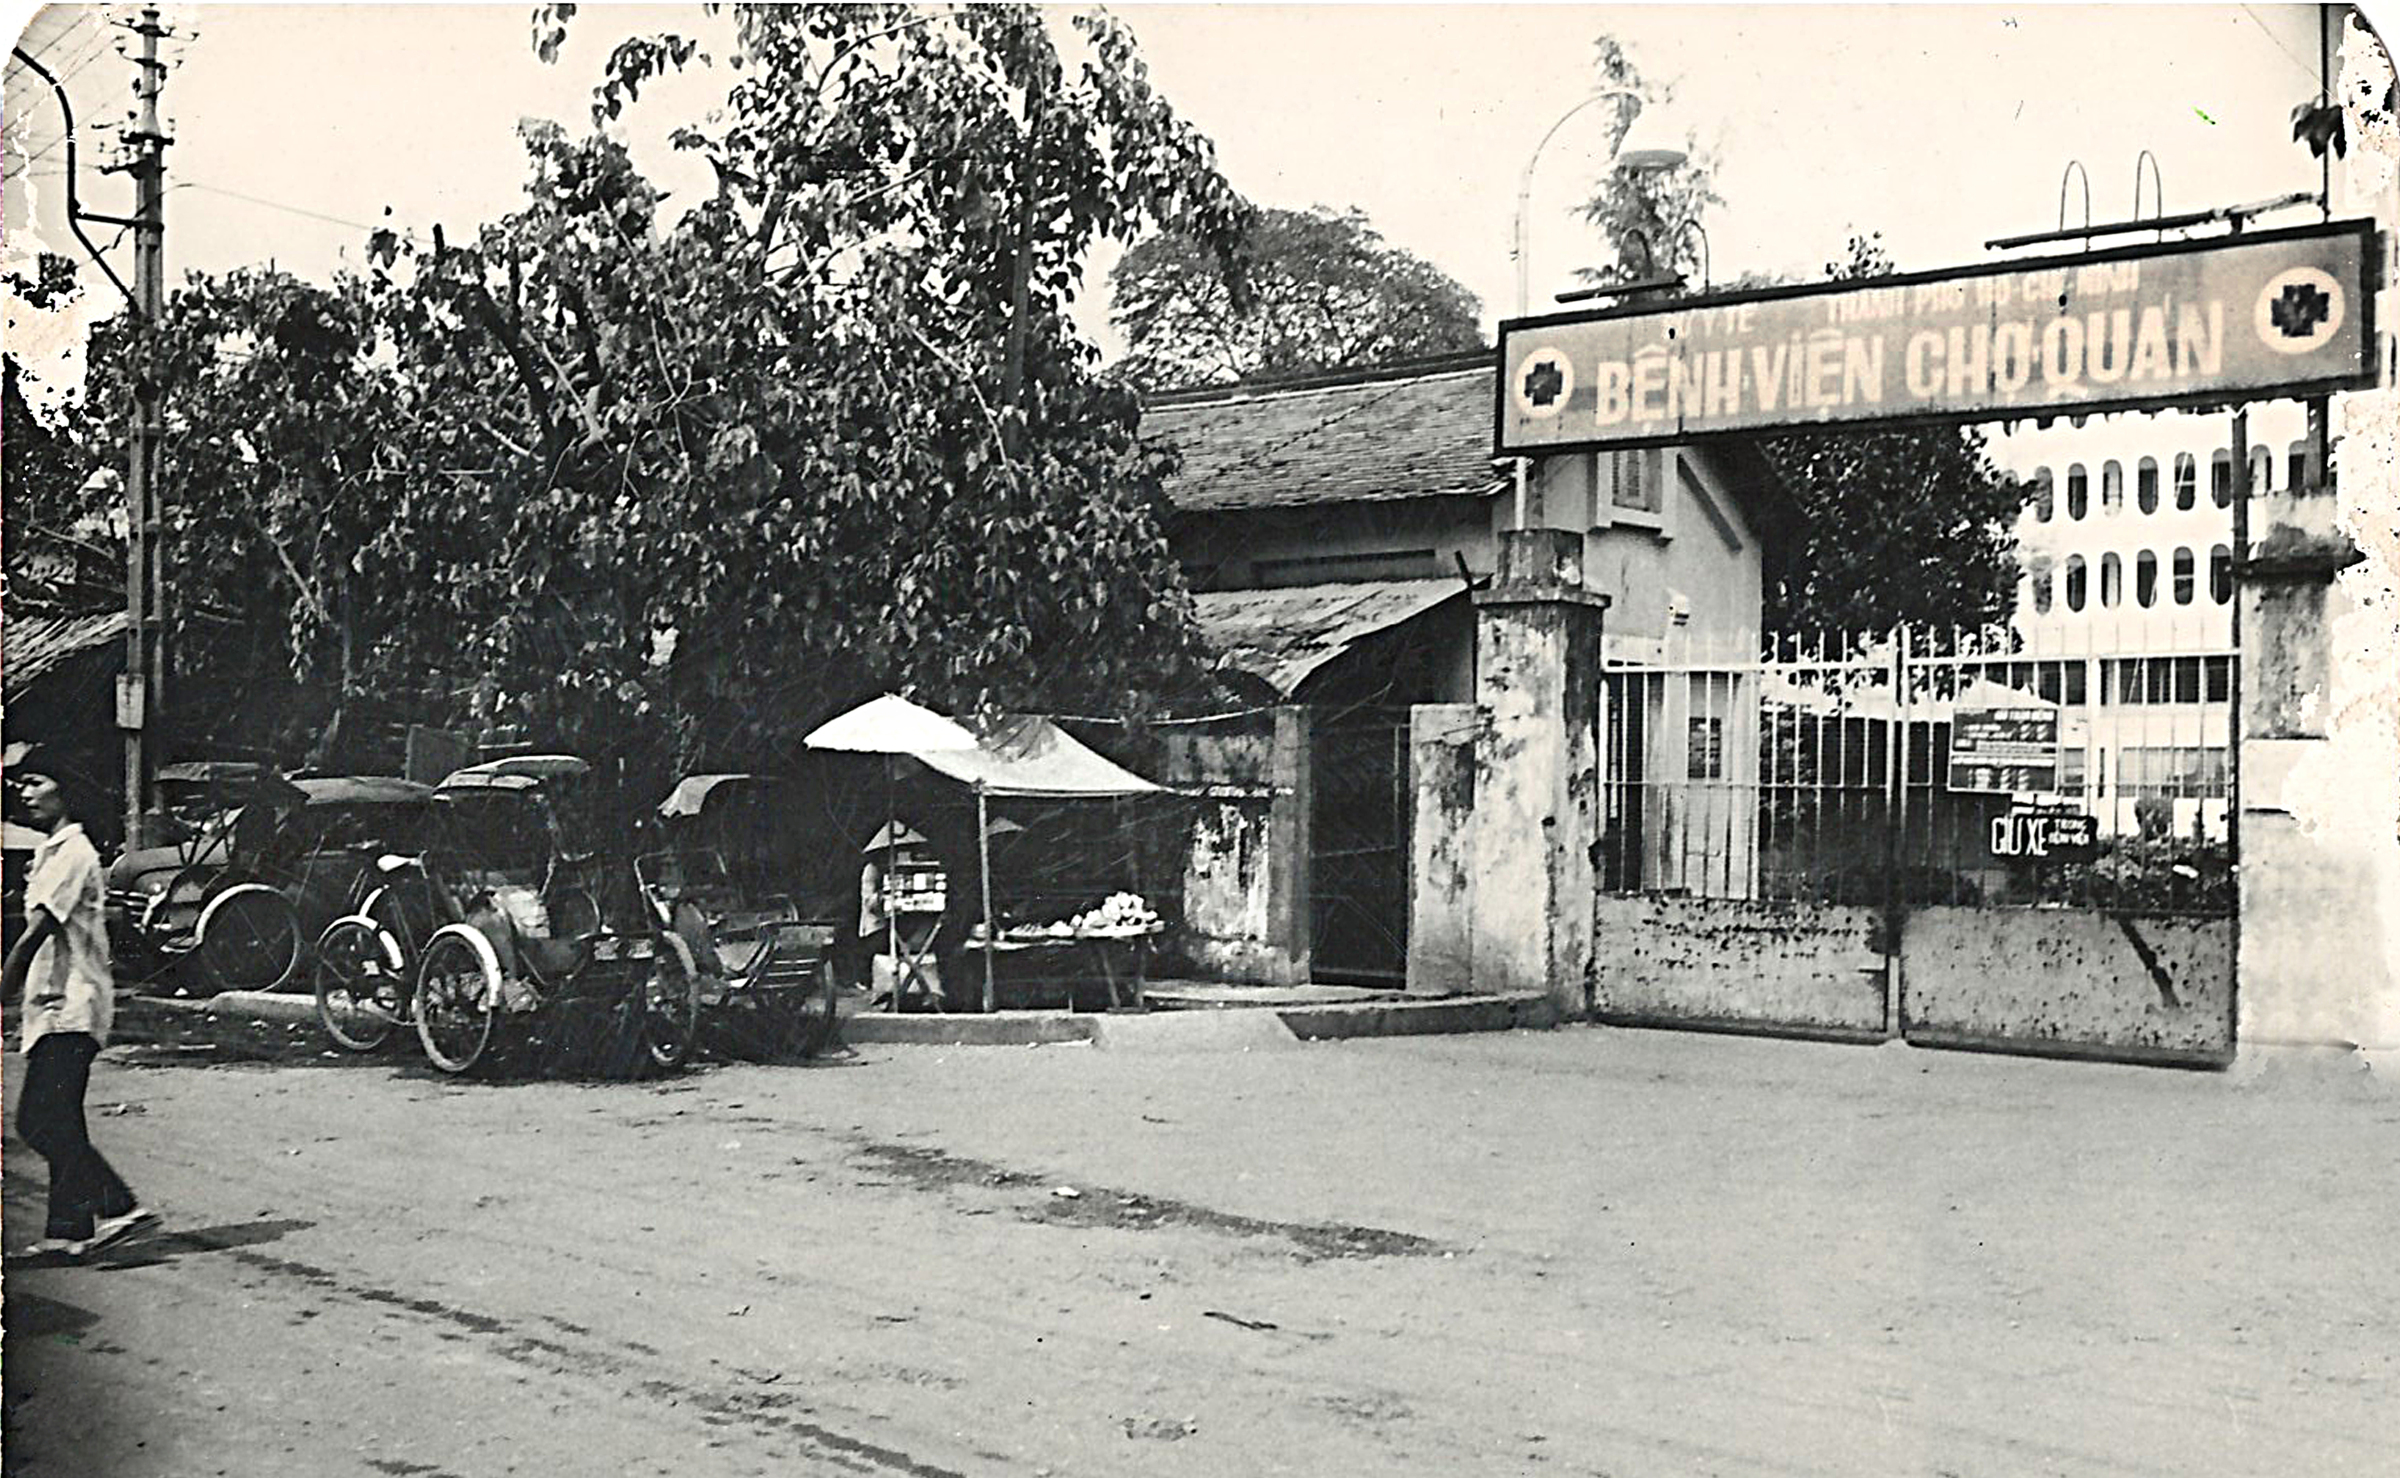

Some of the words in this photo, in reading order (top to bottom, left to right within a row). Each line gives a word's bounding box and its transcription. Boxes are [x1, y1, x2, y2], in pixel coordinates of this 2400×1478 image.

[1595, 343, 1742, 434] BỆNH
[1750, 328, 1884, 420] VIỆN
[2026, 817, 2049, 857] XE
